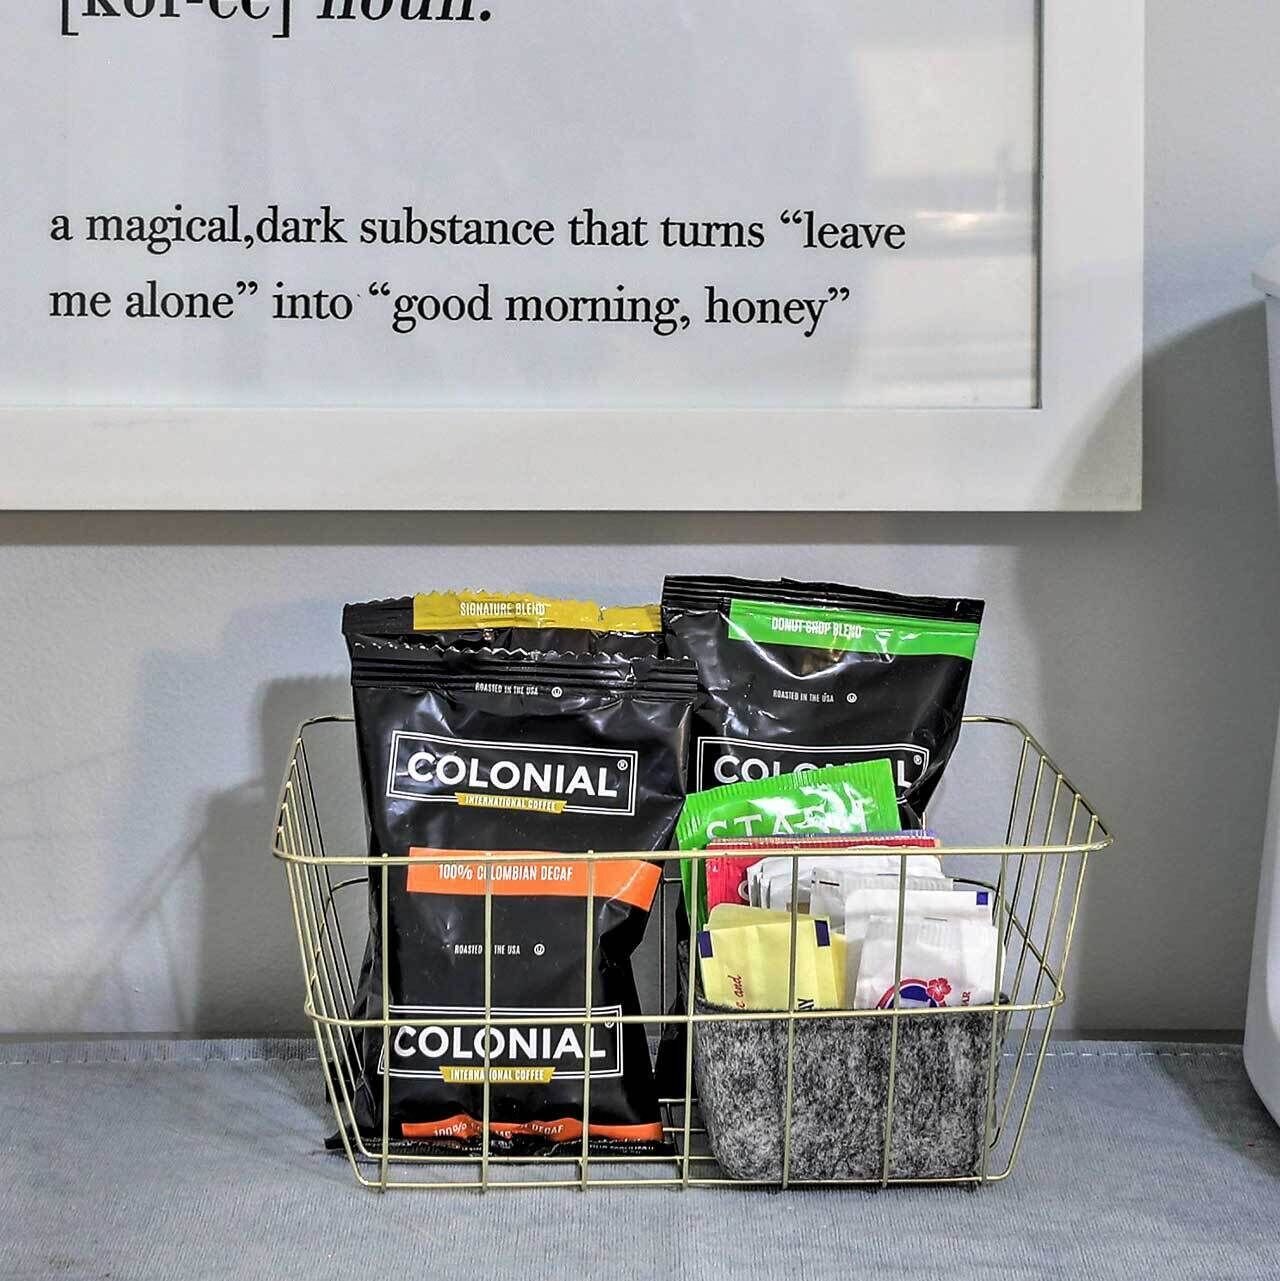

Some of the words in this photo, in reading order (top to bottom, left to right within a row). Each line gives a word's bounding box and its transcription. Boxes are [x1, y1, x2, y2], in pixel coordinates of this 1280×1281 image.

[49, 212, 73, 242] a
[85, 205, 347, 256] magical,dark
[359, 206, 556, 246] substance
[567, 209, 650, 247] that
[659, 214, 765, 249] turns
[779, 210, 907, 251] “leave
[49, 287, 112, 317] me
[124, 279, 259, 318] alone”
[271, 279, 354, 320] into
[368, 280, 493, 334] “good
[504, 284, 693, 335] morning,
[705, 284, 851, 337] honey”
[459, 601, 512, 616] SIGNATURE
[515, 601, 546, 616] BLEND
[771, 616, 803, 633] DONUT
[805, 619, 831, 635] SHOP
[832, 622, 862, 639] BLEND
[475, 682, 502, 694] ROASTED
[504, 685, 512, 694] IN
[513, 685, 524, 695] THE
[526, 686, 539, 696] USA
[773, 689, 799, 701] ROASTED
[800, 693, 808, 702] IN
[809, 693, 820, 703] THE
[822, 693, 835, 703] USA
[407, 750, 619, 798] COLONIAL
[465, 795, 527, 809] INTERNATIONAL
[527, 800, 556, 812] COFFEE
[439, 863, 473, 880] 100%
[541, 866, 573, 882] DECAF
[454, 944, 483, 955] ROASTED
[493, 944, 505, 955] THE
[507, 944, 520, 955] USA
[393, 1025, 607, 1060] COLONIAL
[515, 1069, 545, 1081] COFFEE
